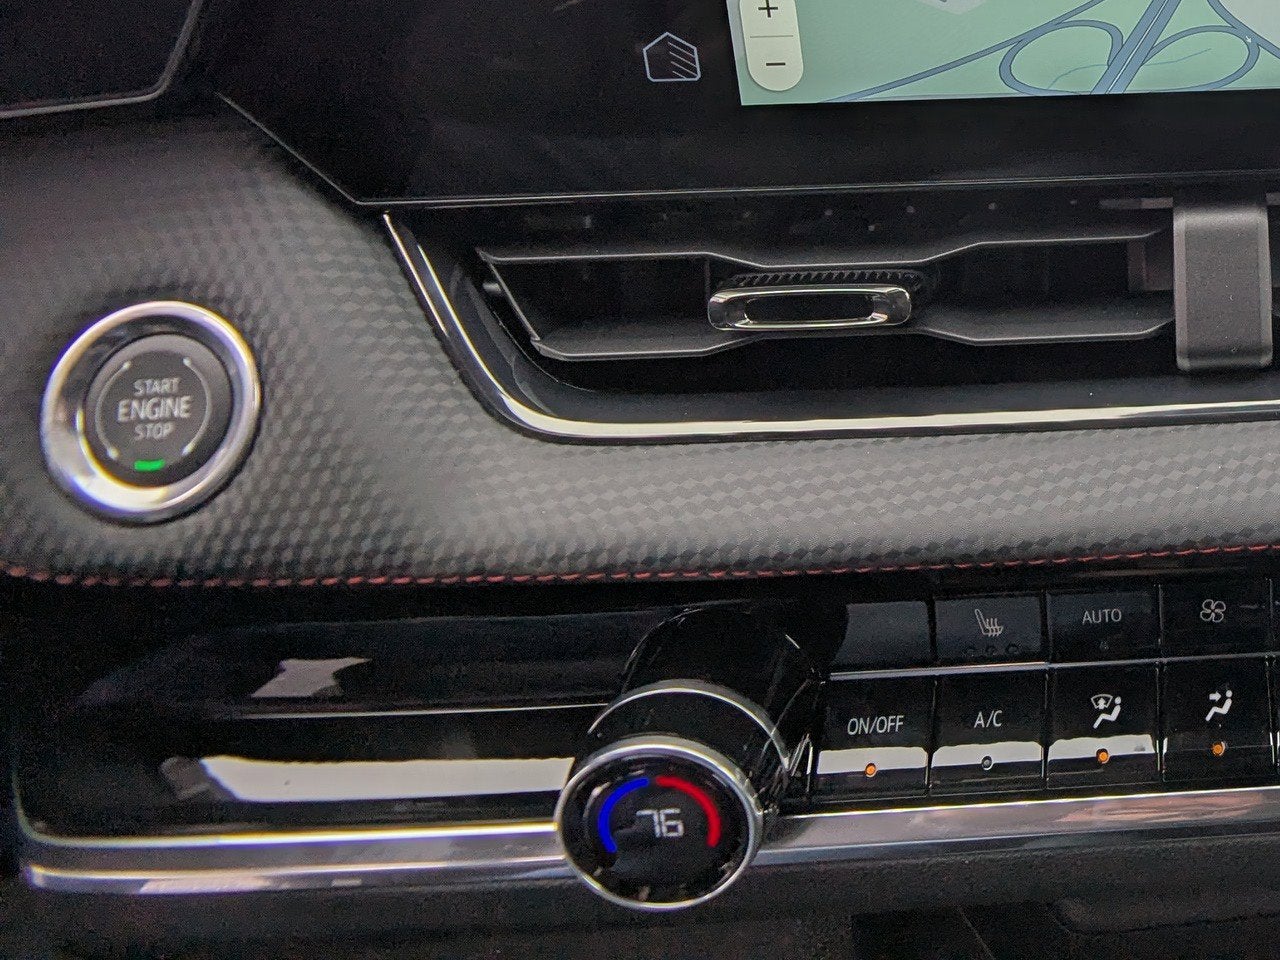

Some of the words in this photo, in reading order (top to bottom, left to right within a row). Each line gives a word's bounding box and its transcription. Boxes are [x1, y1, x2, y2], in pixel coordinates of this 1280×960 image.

[133, 377, 182, 395] START
[116, 395, 193, 423] ENGINE
[133, 422, 177, 442] STOP
[1081, 607, 1123, 626] AUTO
[846, 713, 905, 737] ON/OFF
[973, 709, 1003, 729] A/C
[635, 807, 685, 838] 76
